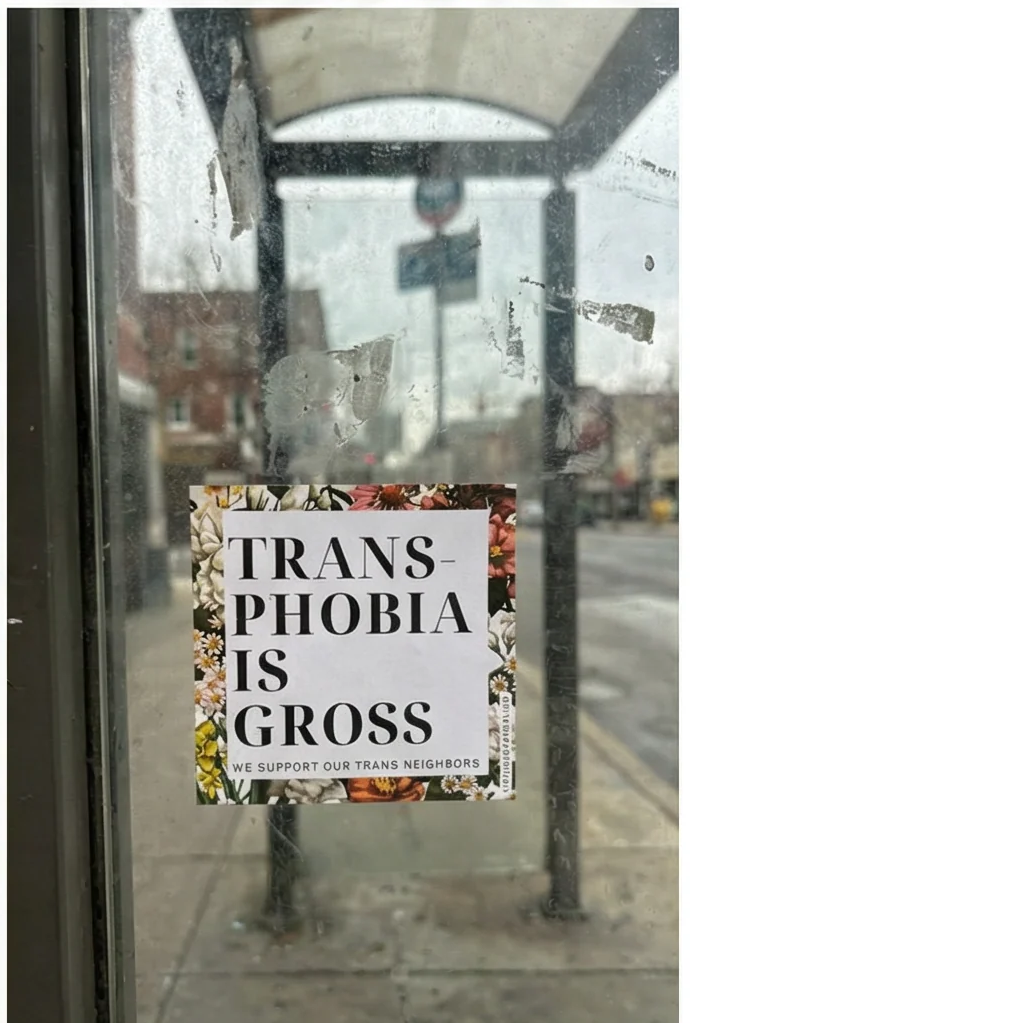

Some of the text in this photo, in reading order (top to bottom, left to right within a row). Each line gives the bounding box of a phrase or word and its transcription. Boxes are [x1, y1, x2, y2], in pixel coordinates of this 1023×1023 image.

[228, 536, 456, 580] TRANS-
[230, 591, 473, 636] PHOBIA
[232, 648, 288, 692] IS
[234, 701, 433, 748] GROSS
[232, 758, 480, 773] WE SUPPORT OUR TRANS NEIGHBORS
